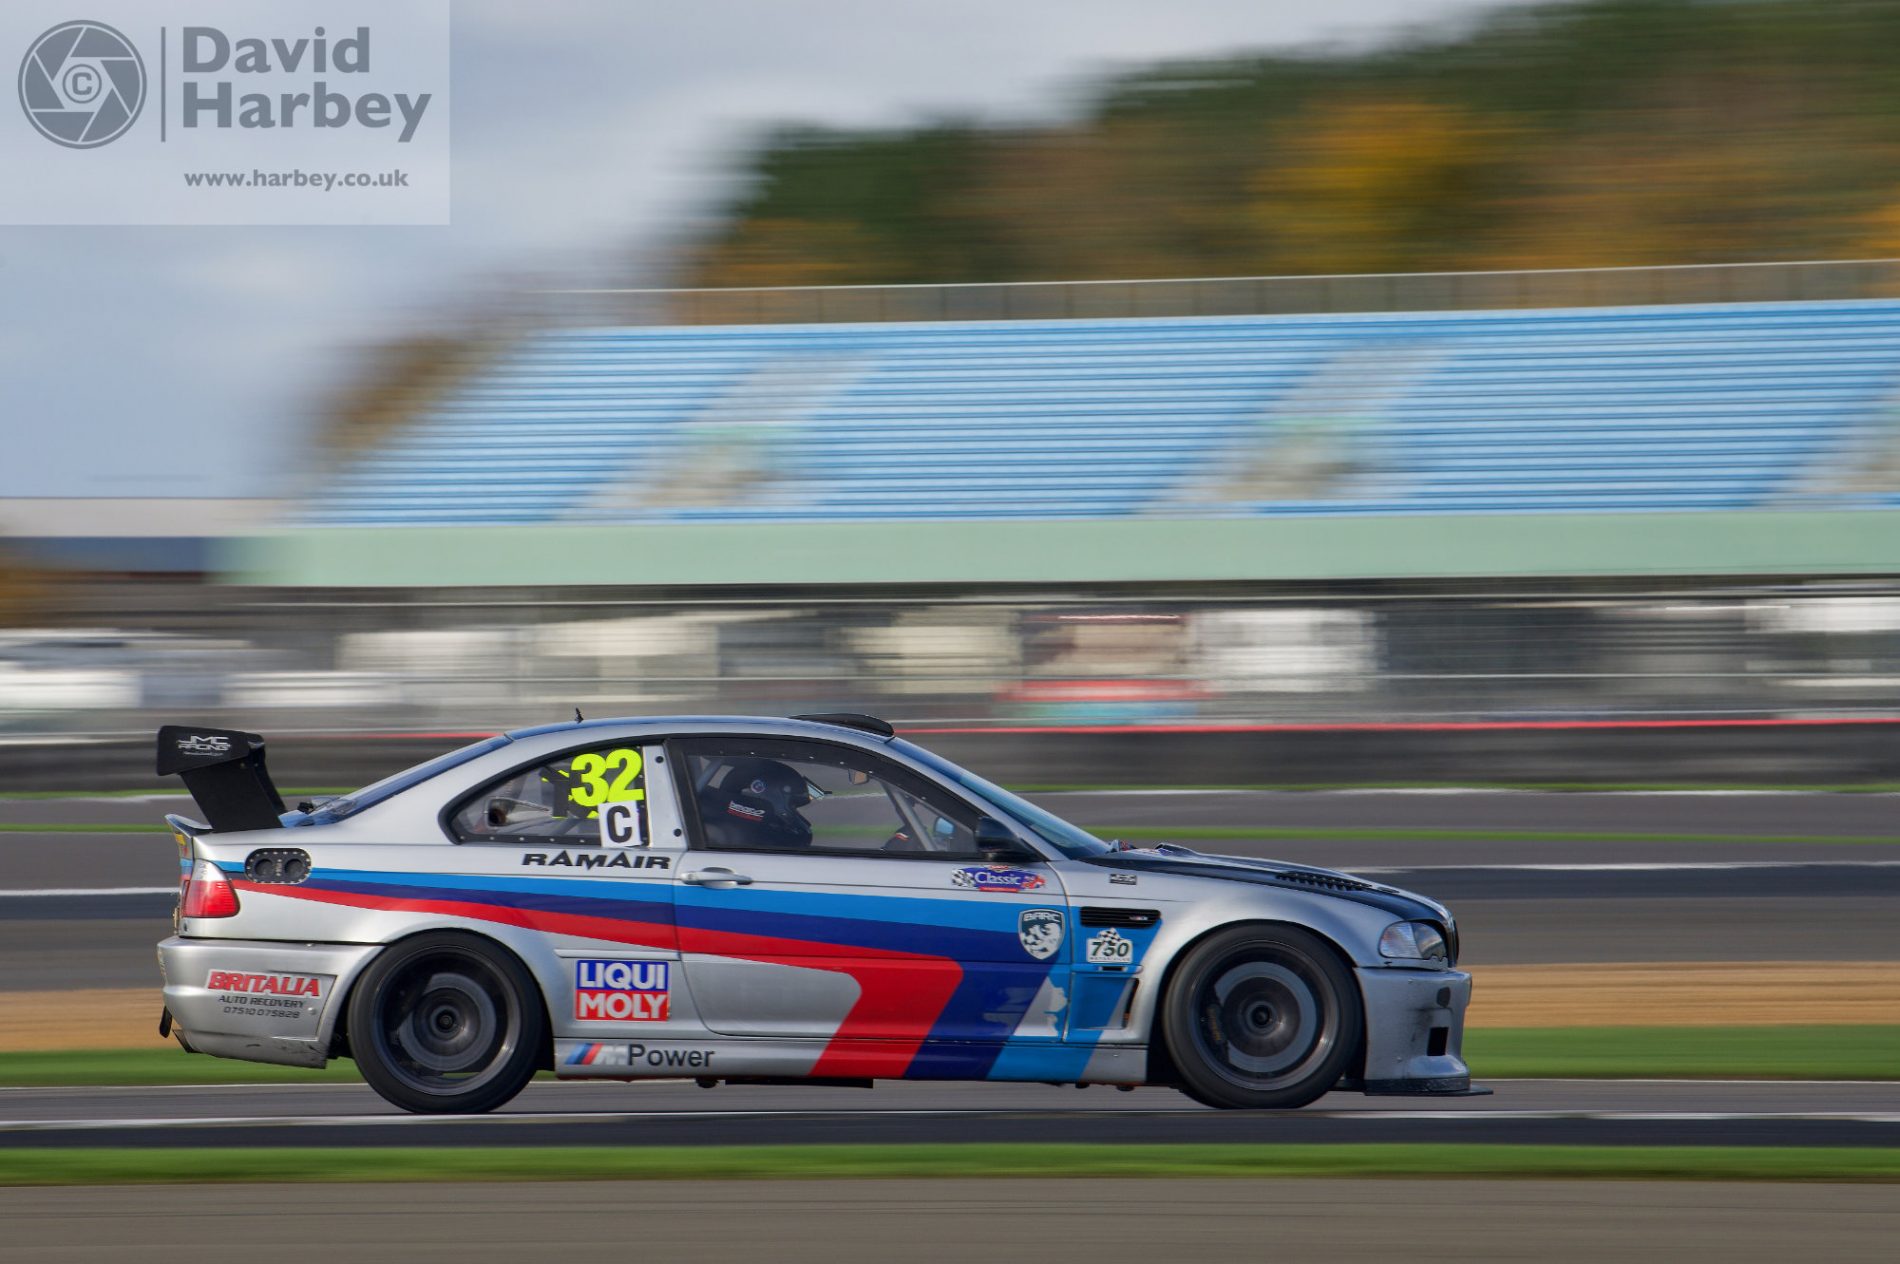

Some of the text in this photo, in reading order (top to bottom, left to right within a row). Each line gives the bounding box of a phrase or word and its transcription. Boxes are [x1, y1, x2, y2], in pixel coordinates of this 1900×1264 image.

[571, 749, 644, 807] 32
[606, 805, 633, 843] C
[522, 850, 671, 870] RAMAIR
[974, 872, 1021, 885] Classic
[1023, 912, 1061, 923] BARC
[1091, 940, 1130, 958] 750
[207, 971, 320, 997] BRITALIA
[579, 962, 666, 990] LIQUI
[218, 995, 248, 1005] AUTO
[249, 997, 305, 1008] RECOVERY
[579, 992, 667, 1018] MOLY
[628, 1043, 715, 1068] Power
